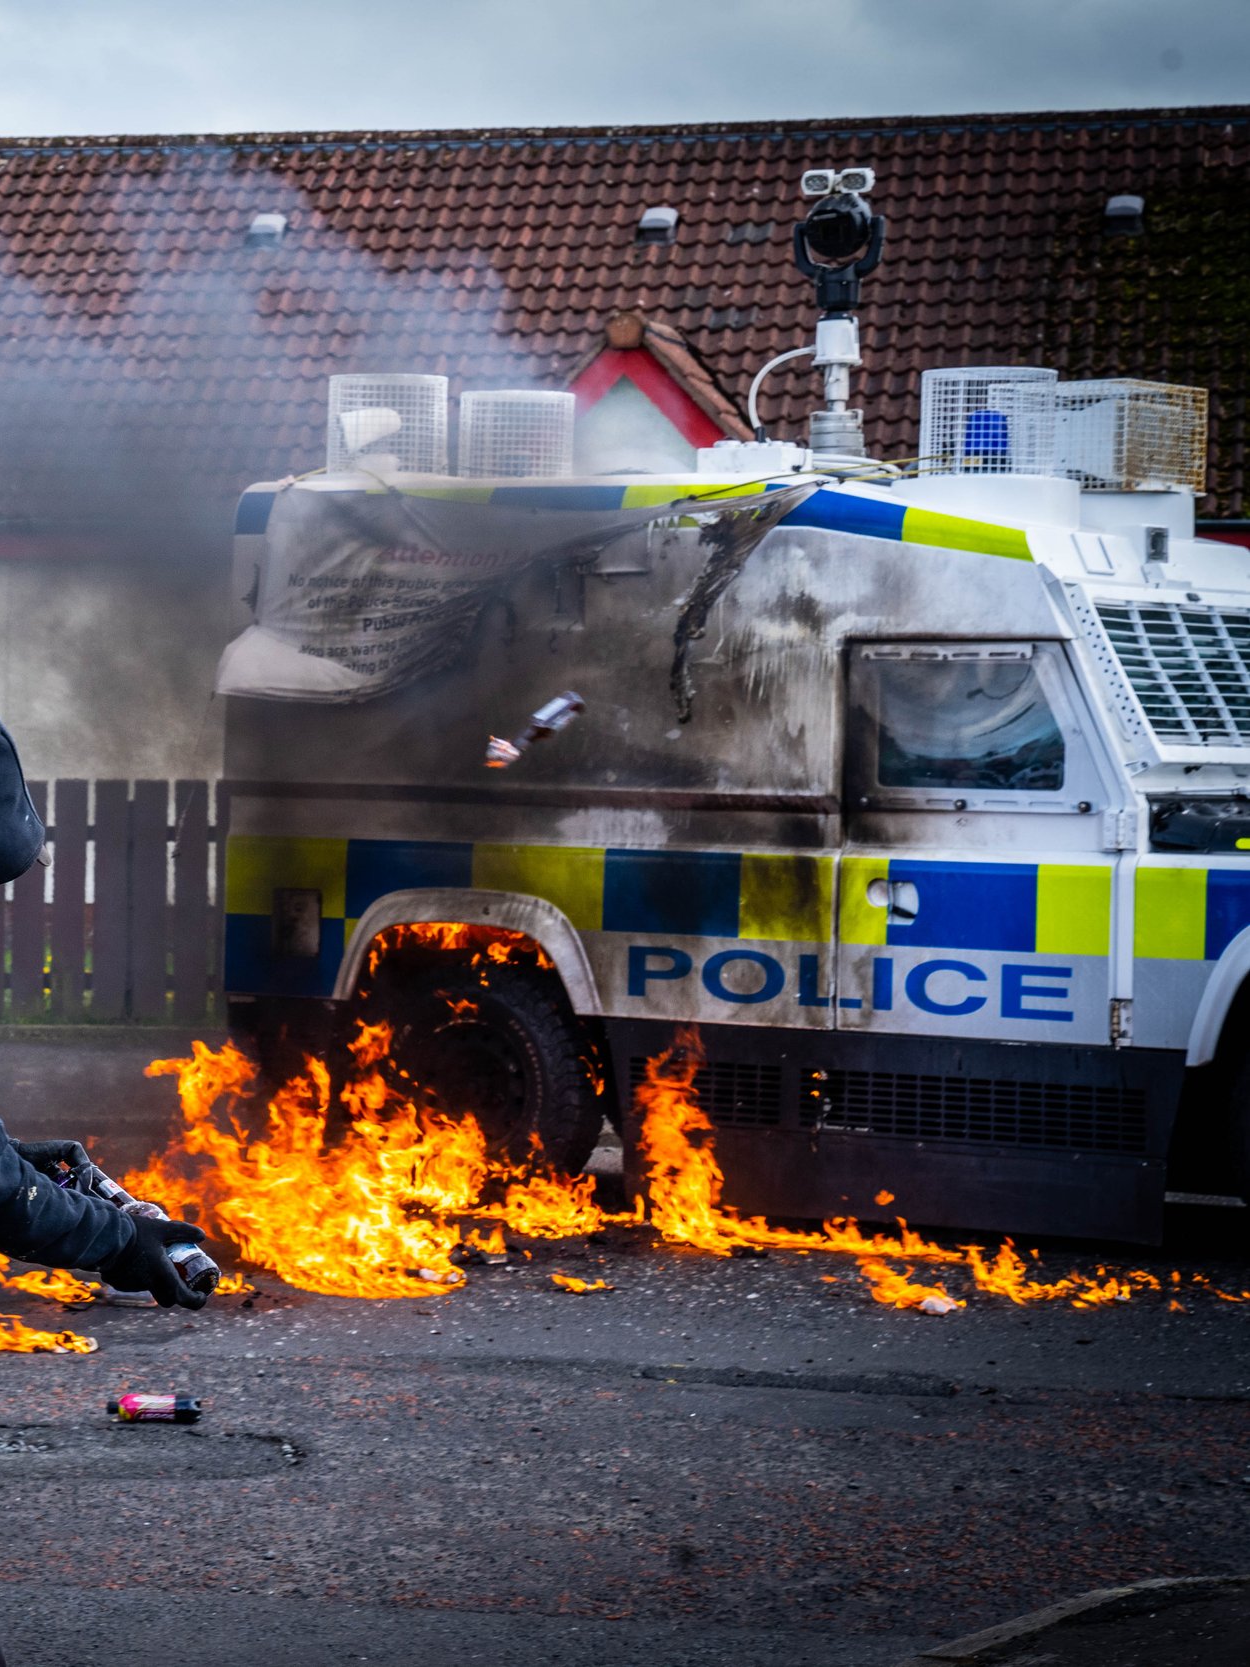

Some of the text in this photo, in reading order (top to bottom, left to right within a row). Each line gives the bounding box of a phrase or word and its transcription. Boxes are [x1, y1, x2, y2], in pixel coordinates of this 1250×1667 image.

[288, 573, 305, 587] No
[397, 577, 440, 592] public
[307, 595, 322, 609] of
[324, 596, 347, 609] the
[348, 595, 391, 609] Police
[627, 945, 1074, 1022] POLICE
